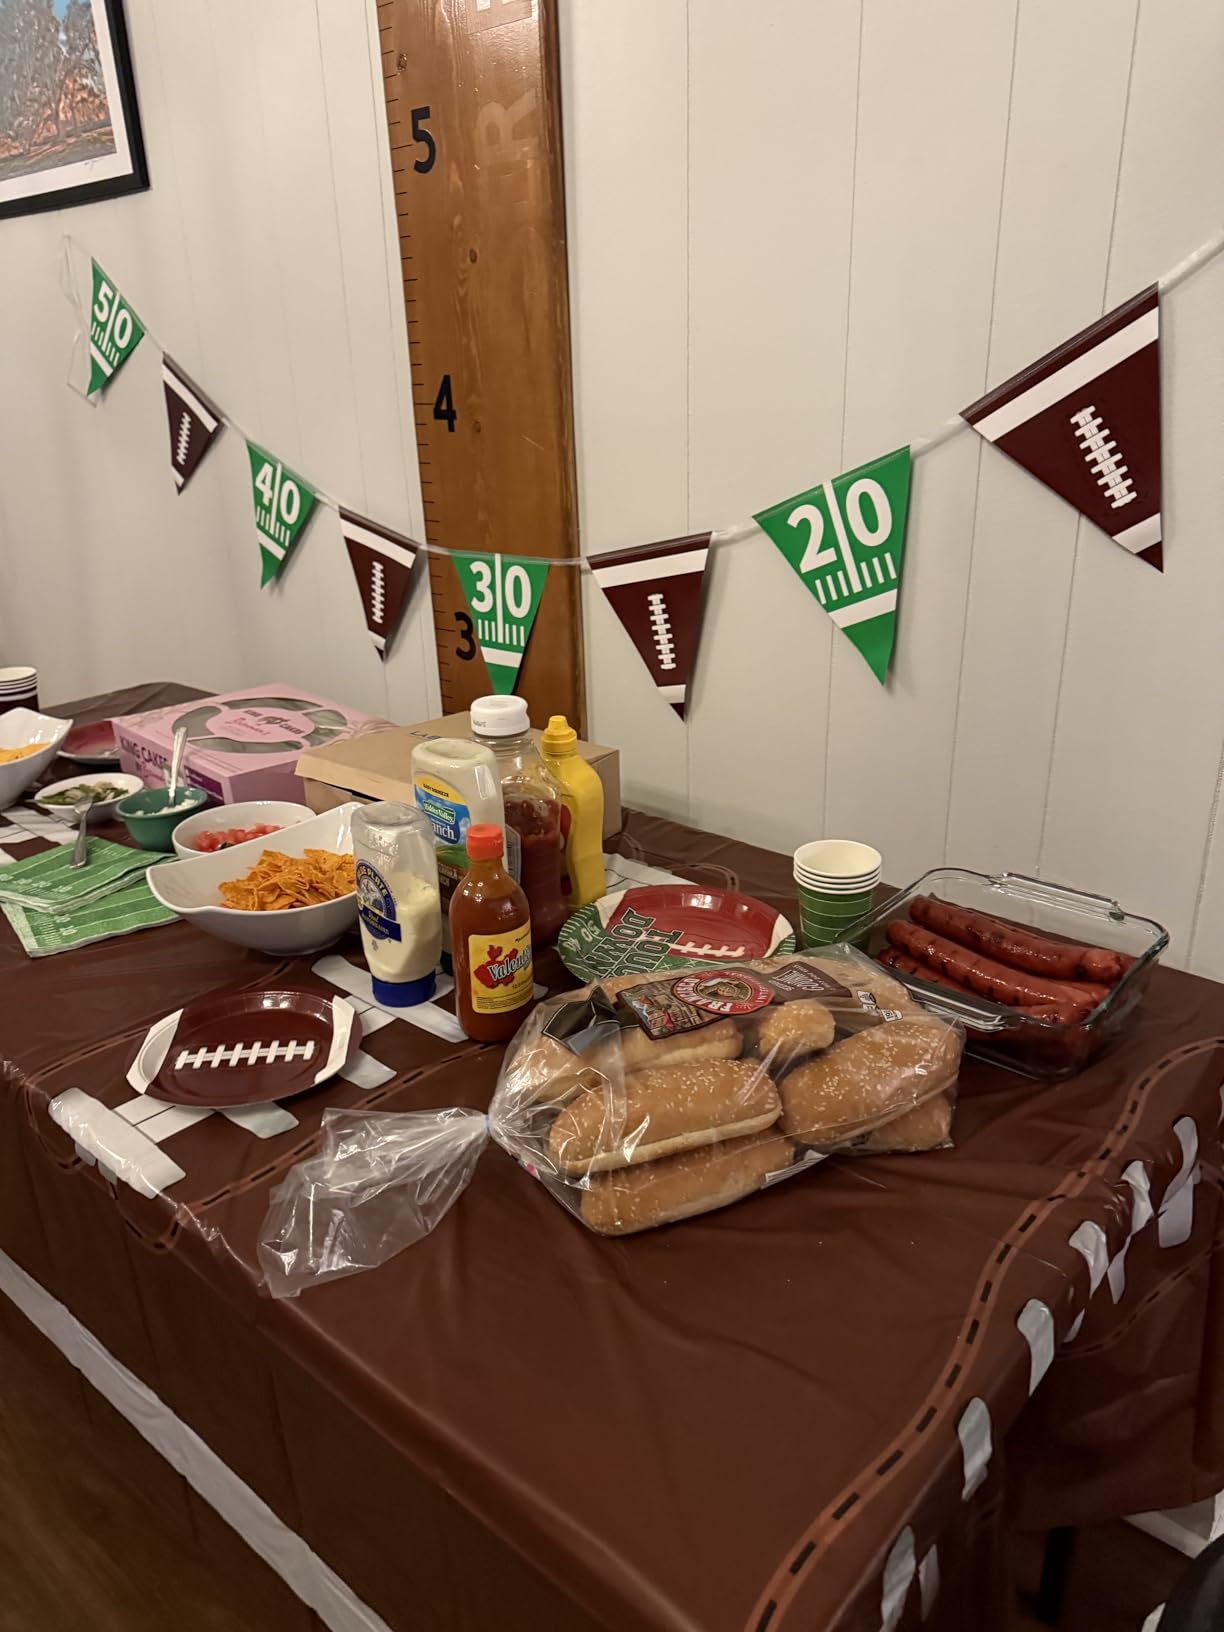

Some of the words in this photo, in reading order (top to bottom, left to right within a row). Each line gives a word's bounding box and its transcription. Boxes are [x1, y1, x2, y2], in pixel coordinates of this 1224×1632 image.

[411, 106, 436, 174] 5
[94, 280, 133, 349] 50
[433, 374, 457, 432] 4
[255, 462, 300, 525] 40
[787, 478, 892, 574] 20
[469, 560, 532, 619] 30
[454, 611, 477, 661] 3
[366, 868, 388, 897] PLATE
[606, 929, 684, 978] TOUC
[675, 978, 733, 1012] FRANCISCO
